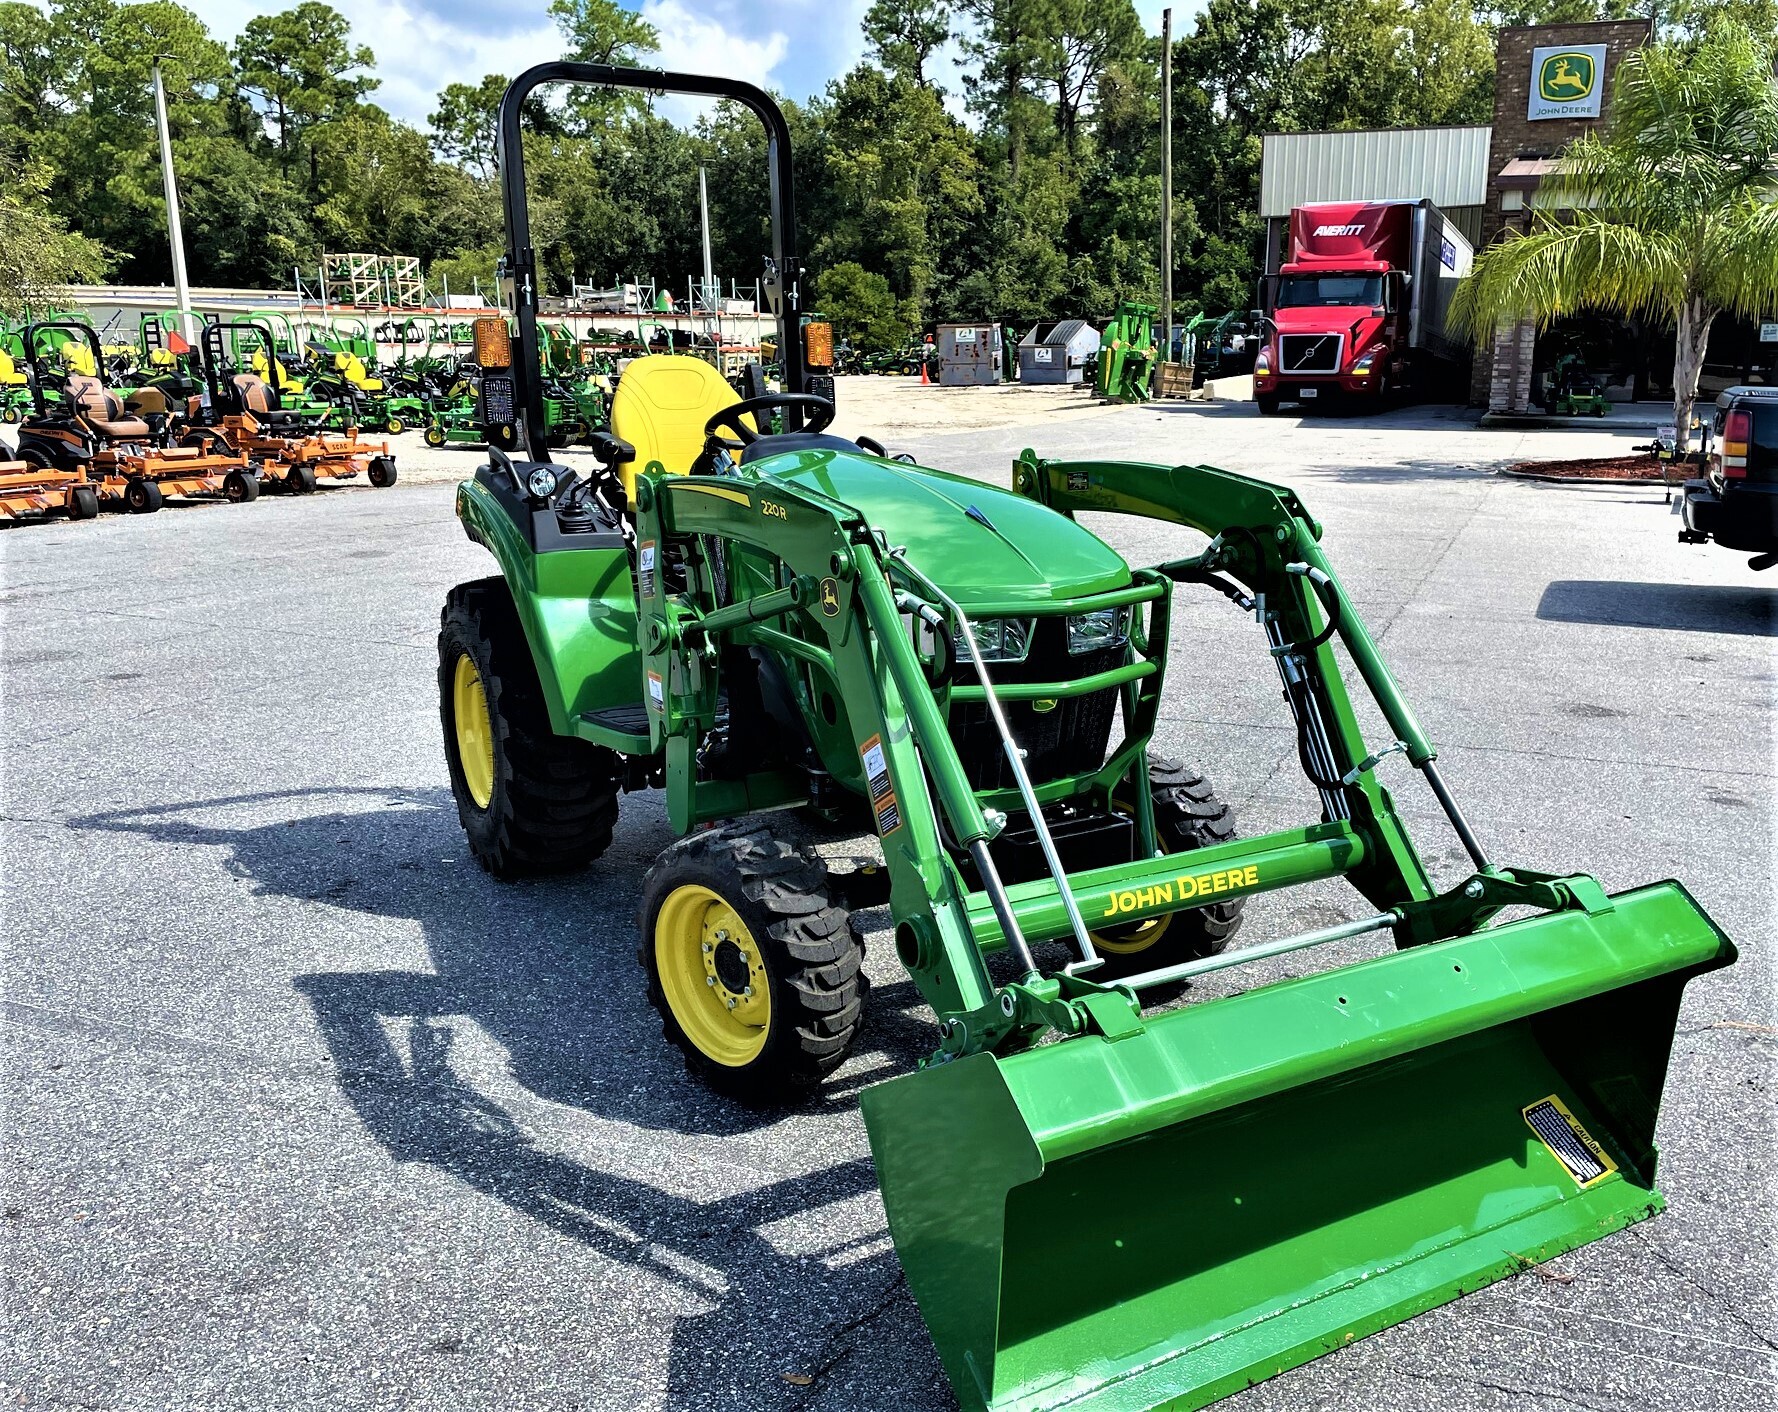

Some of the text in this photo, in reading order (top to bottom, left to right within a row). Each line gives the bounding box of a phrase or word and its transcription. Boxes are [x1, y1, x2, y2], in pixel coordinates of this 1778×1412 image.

[1536, 106, 1592, 116] JOHN DEERE
[1312, 224, 1366, 237] AVERITT
[1103, 865, 1259, 917] JOHN DEERE
[1573, 1124, 1602, 1155] CAUTION
